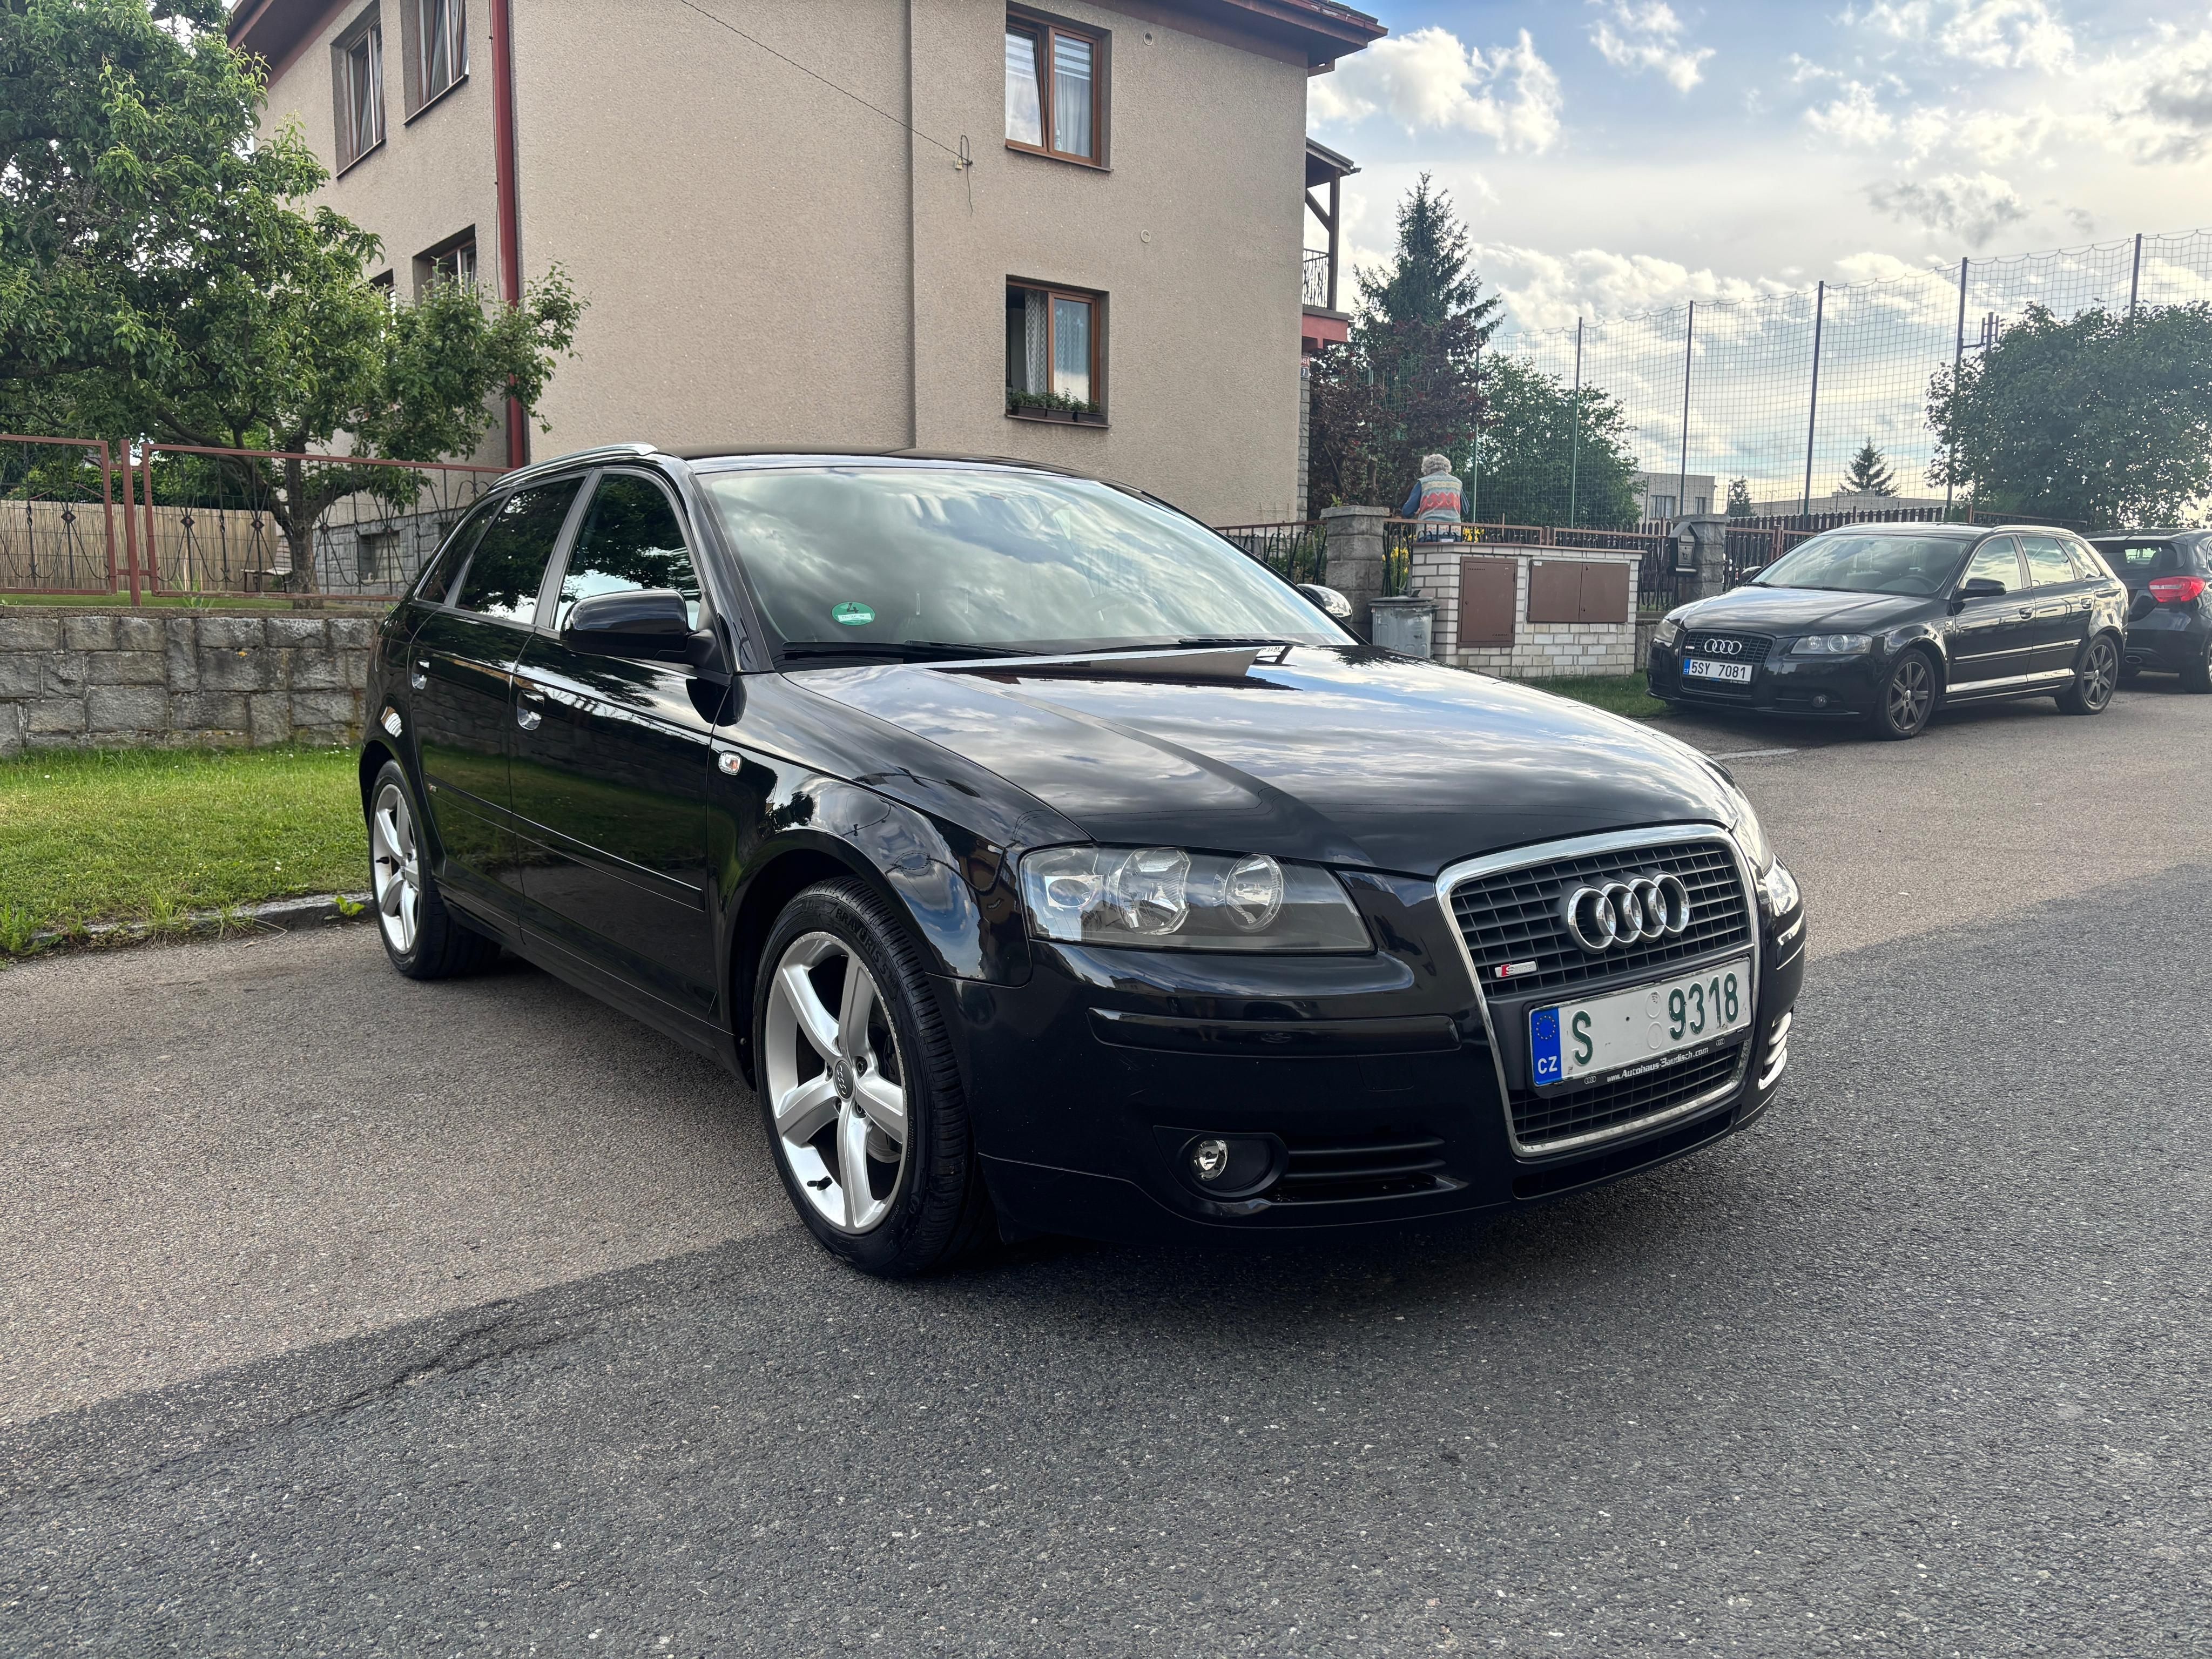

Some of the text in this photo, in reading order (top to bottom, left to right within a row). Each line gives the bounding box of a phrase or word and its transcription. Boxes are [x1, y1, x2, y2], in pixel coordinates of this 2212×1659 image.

[847, 602, 859, 613] 4
[1691, 662, 1745, 679] 5SY 7081
[1572, 971, 1738, 1066] S 9318
[1537, 1056, 1558, 1075] CZ
